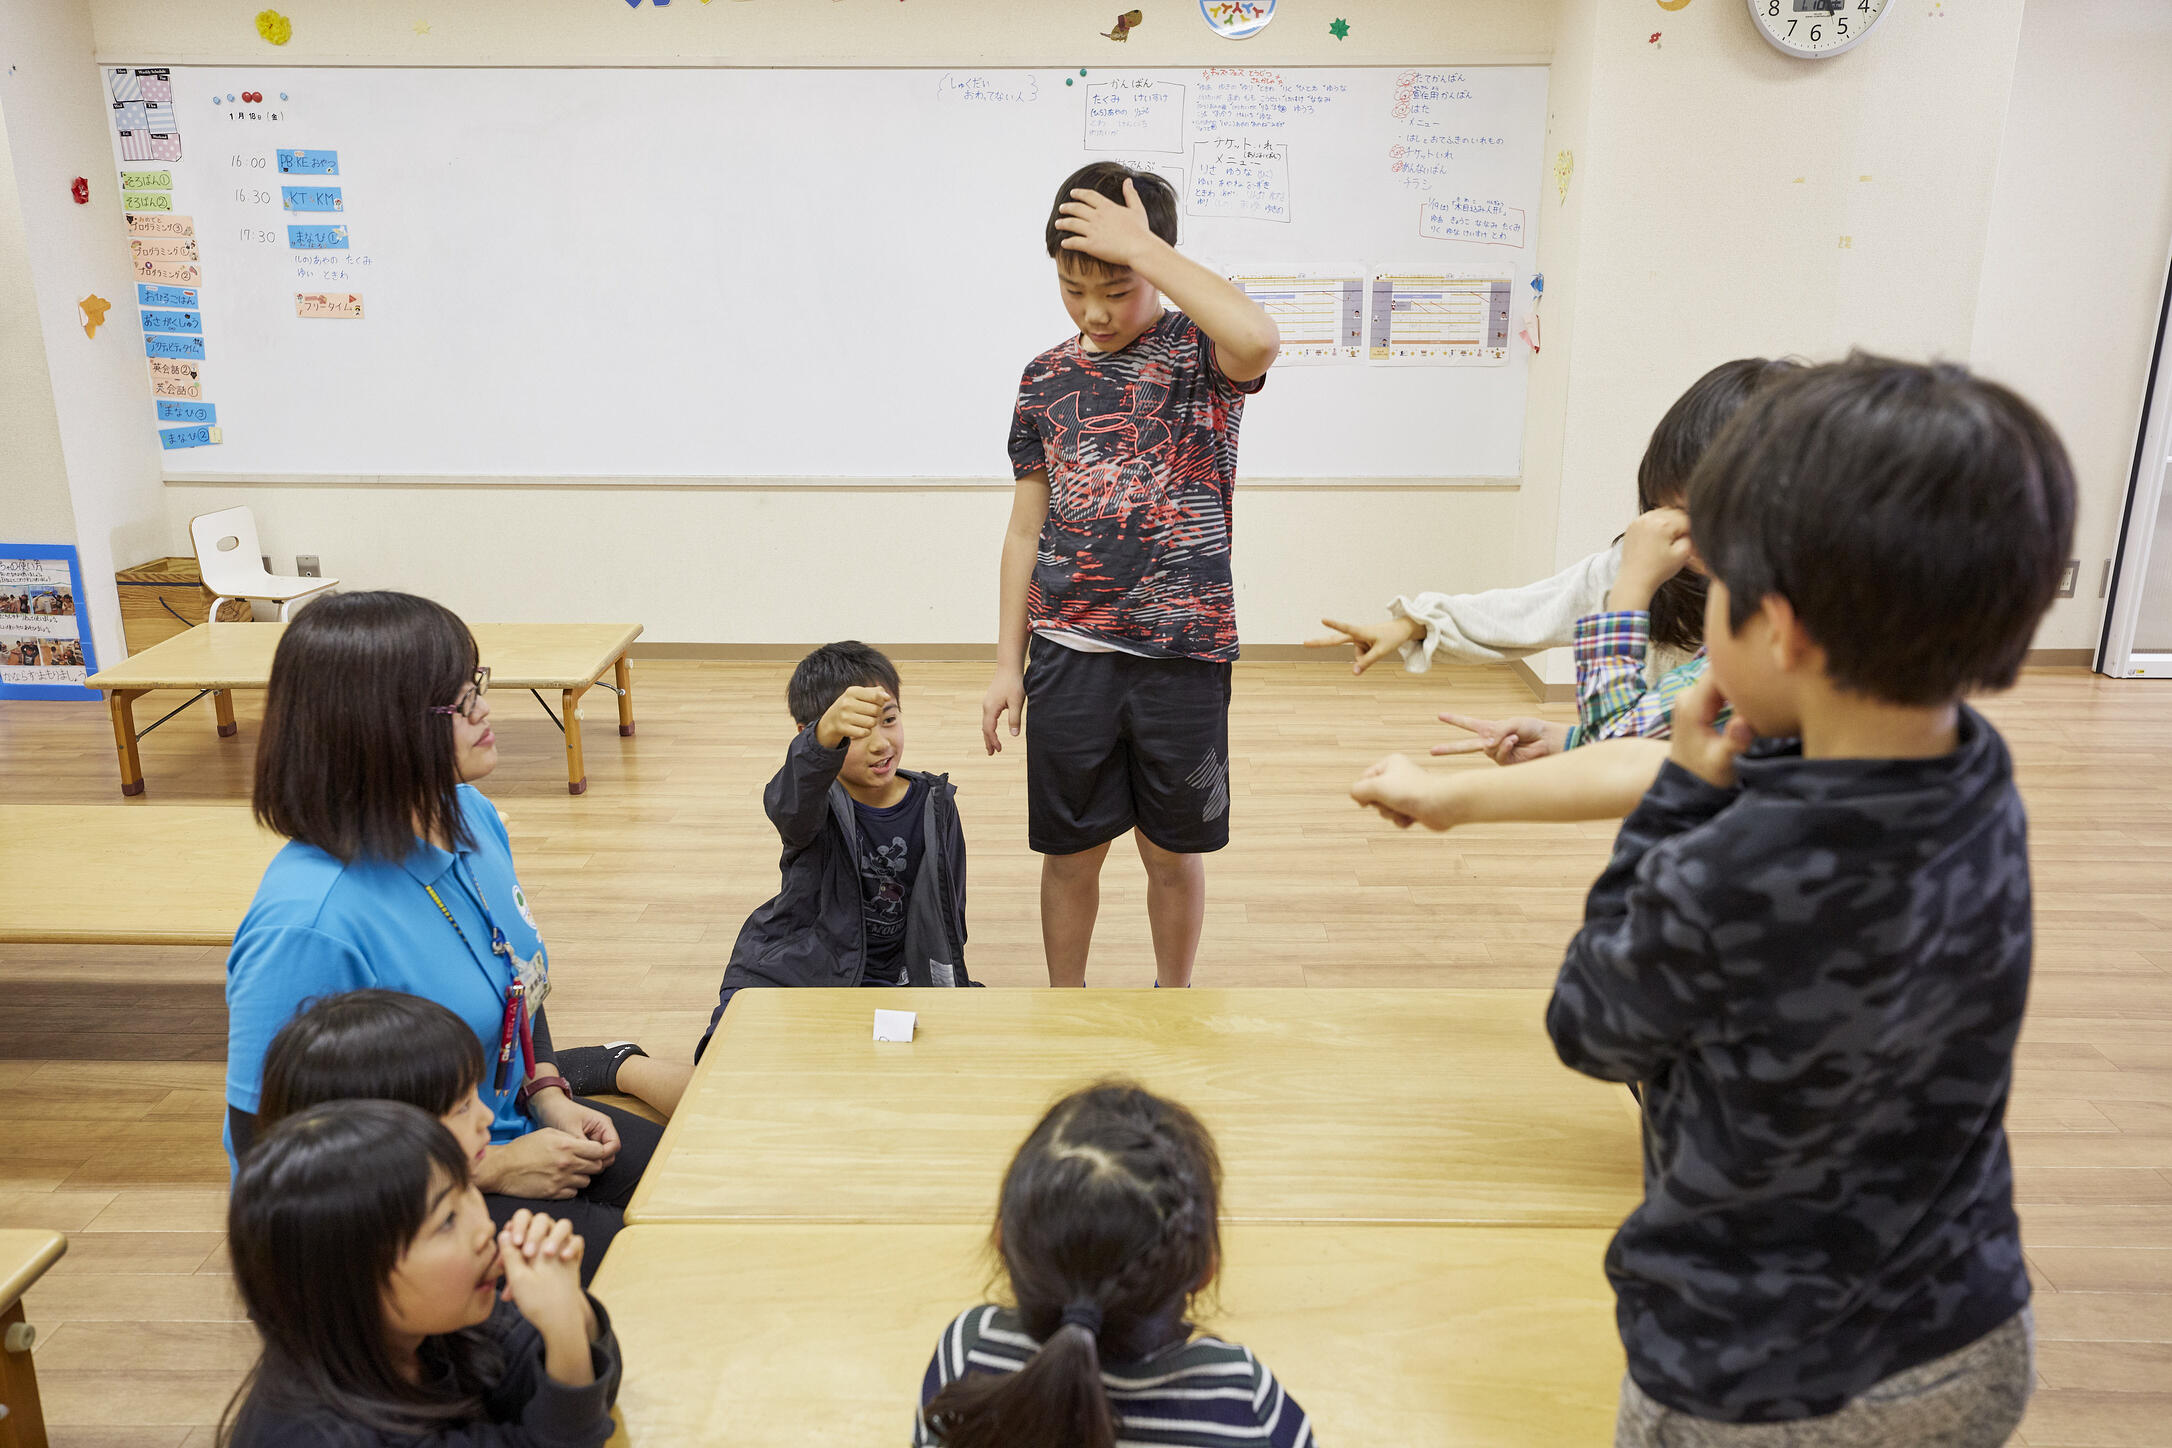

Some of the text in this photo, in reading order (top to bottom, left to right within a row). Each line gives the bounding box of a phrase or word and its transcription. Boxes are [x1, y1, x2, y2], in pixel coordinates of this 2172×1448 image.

[1768, 0, 1780, 16] 8
[1857, 0, 1870, 13] 4
[1787, 20, 1798, 37] 7
[1810, 24, 1822, 41] 6
[1837, 17, 1848, 34] 5
[1410, 103, 1431, 114] はた
[1409, 117, 1441, 128] メニュー
[1215, 153, 1262, 166] メニュー
[1403, 176, 1433, 191] チラシ
[304, 302, 352, 312] フリータイム
[152, 362, 191, 376] 英会話②
[156, 383, 199, 398] 英会話①
[1057, 459, 1172, 524] UA
